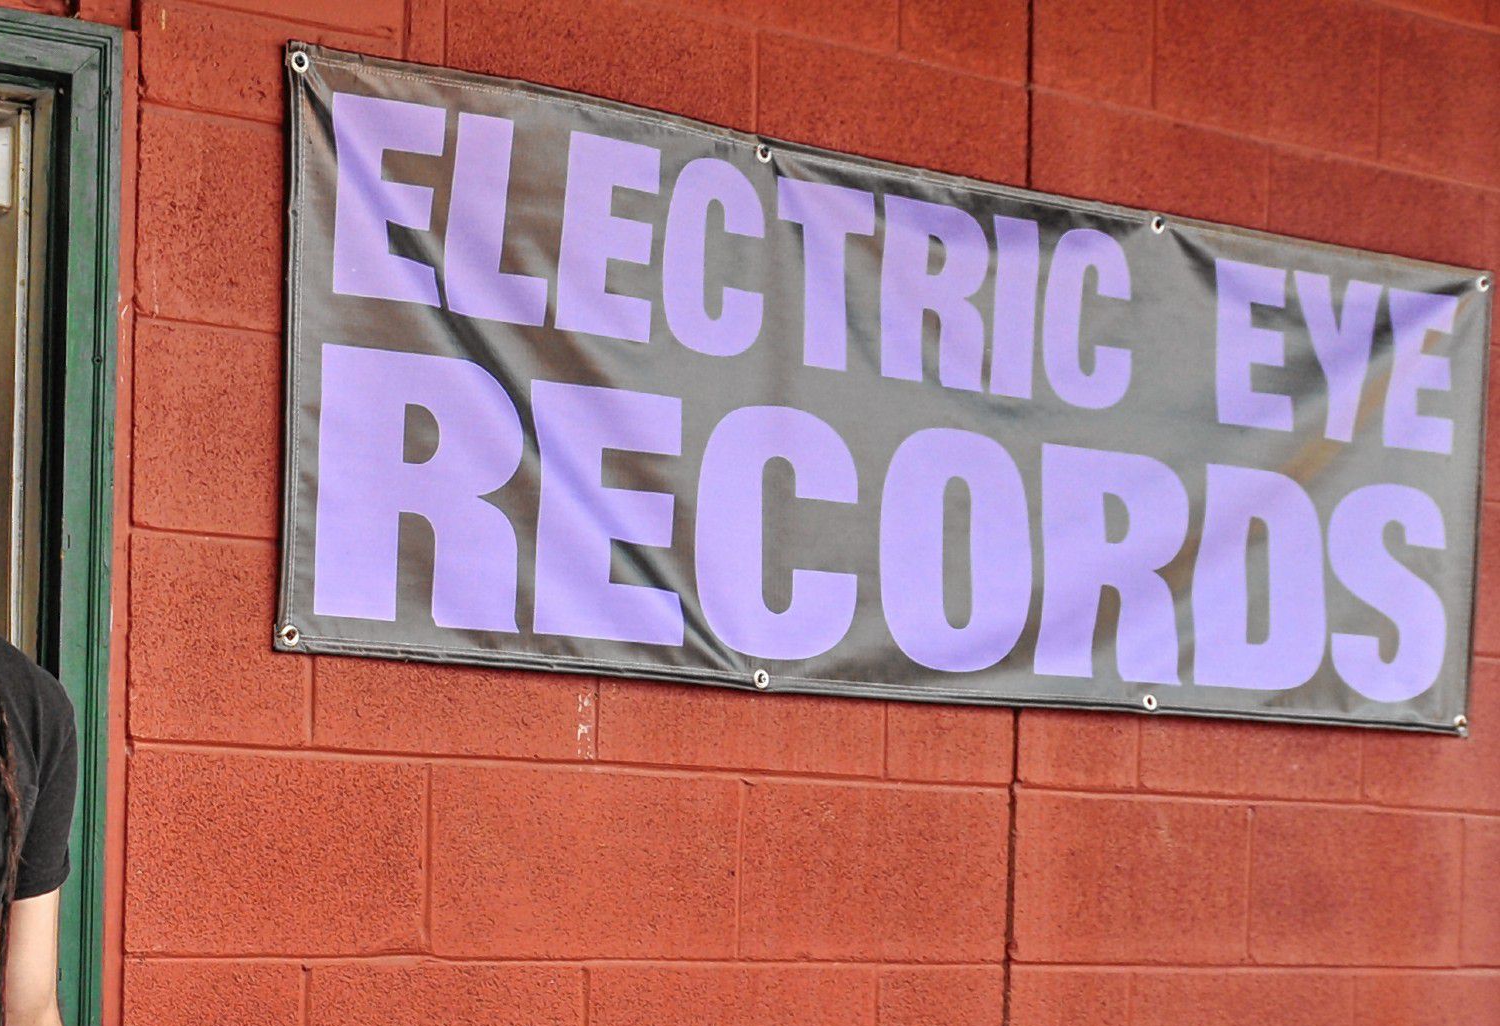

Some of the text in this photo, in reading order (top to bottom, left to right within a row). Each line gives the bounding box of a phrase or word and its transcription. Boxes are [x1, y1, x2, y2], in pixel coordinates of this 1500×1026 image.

[333, 92, 1458, 455] ELECTRIC EYE
[313, 344, 1447, 704] RECORDS
